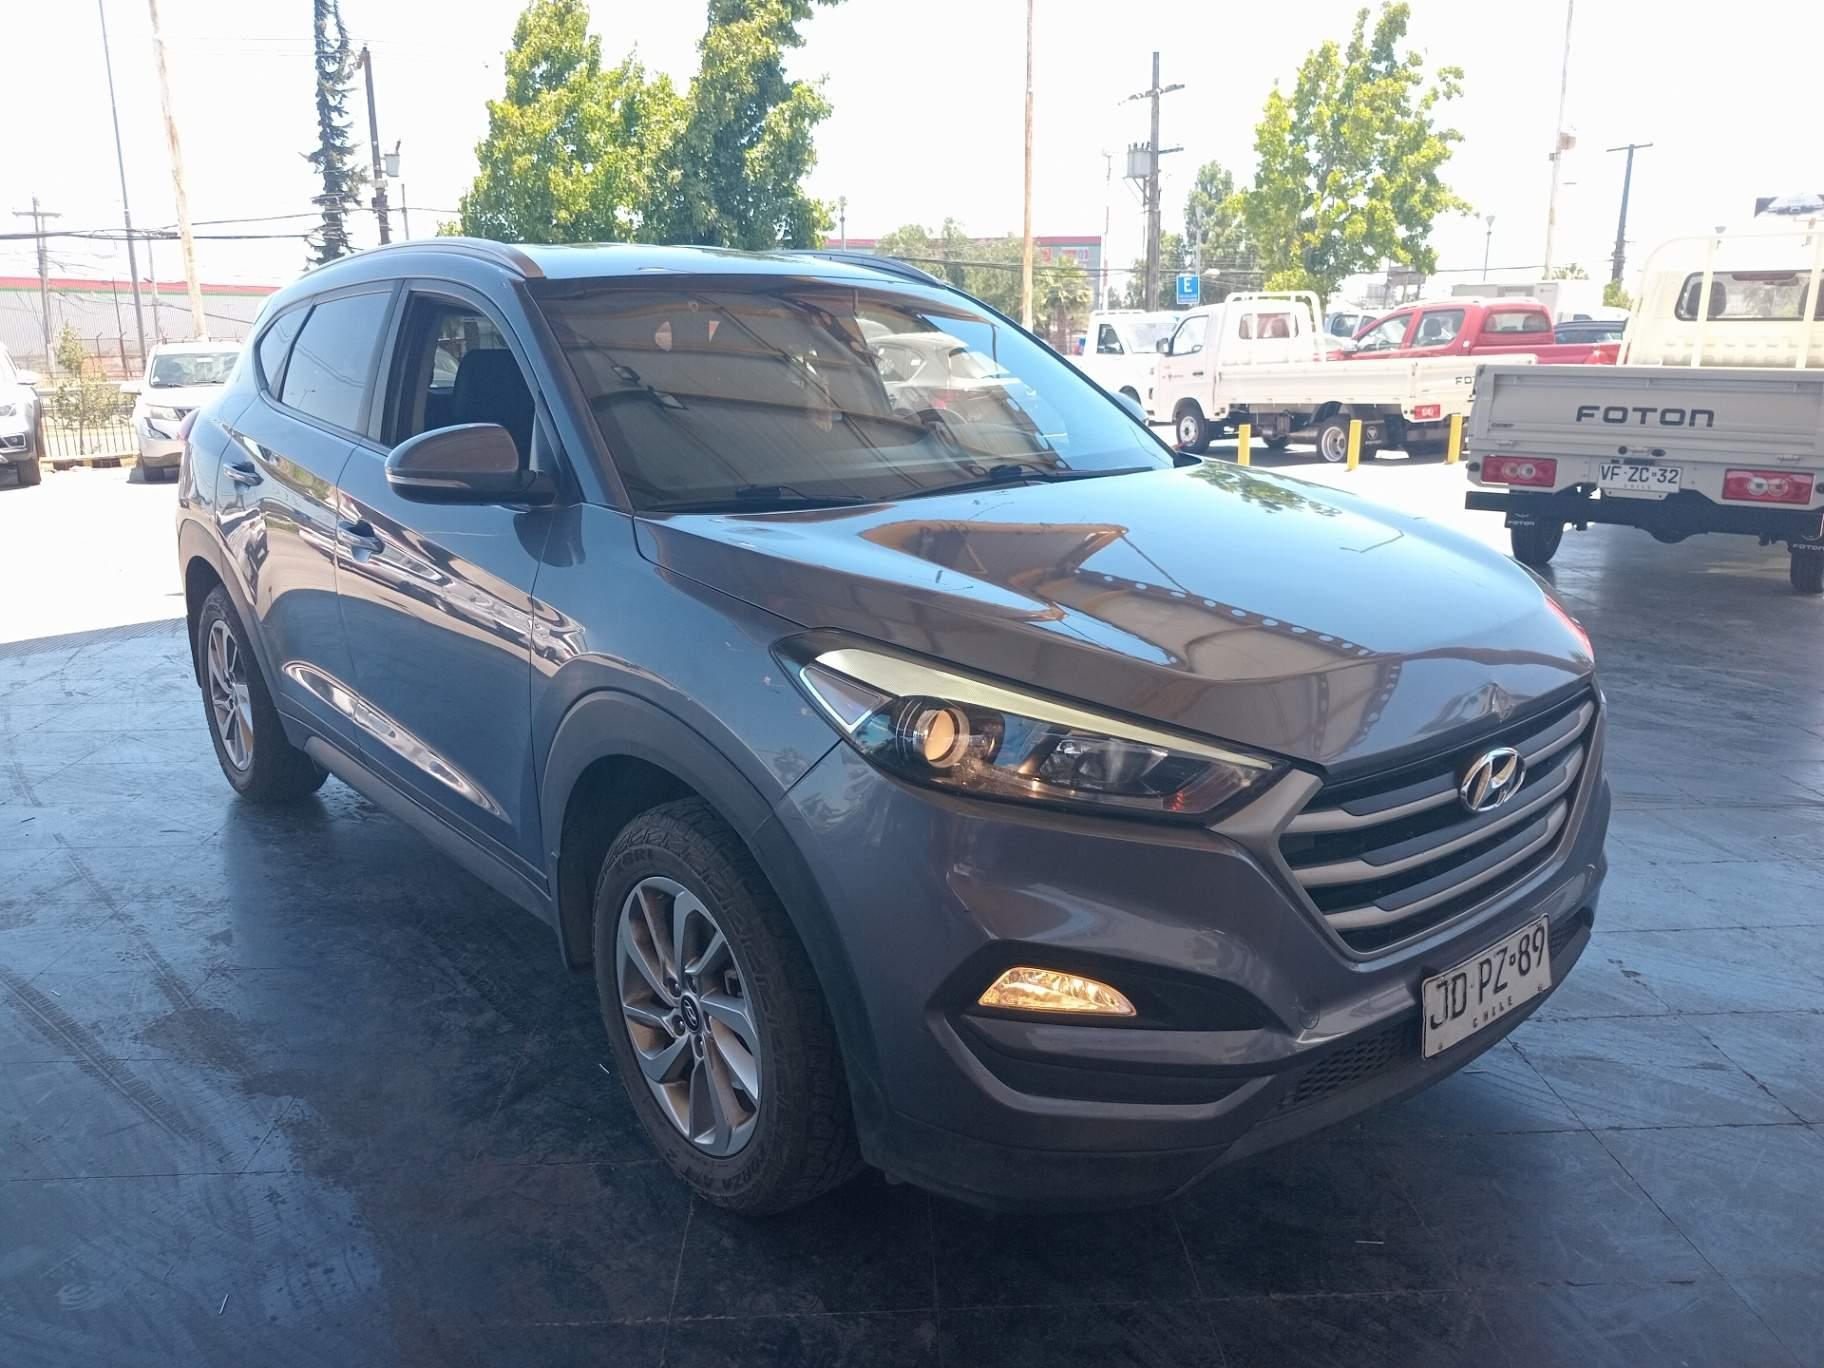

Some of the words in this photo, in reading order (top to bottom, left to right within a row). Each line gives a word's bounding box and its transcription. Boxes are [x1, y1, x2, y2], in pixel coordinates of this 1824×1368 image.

[1183, 277, 1193, 293] E
[1455, 376, 1475, 385] FO
[1576, 405, 1715, 427] FOTON
[1472, 995, 1513, 1029] CHILE
